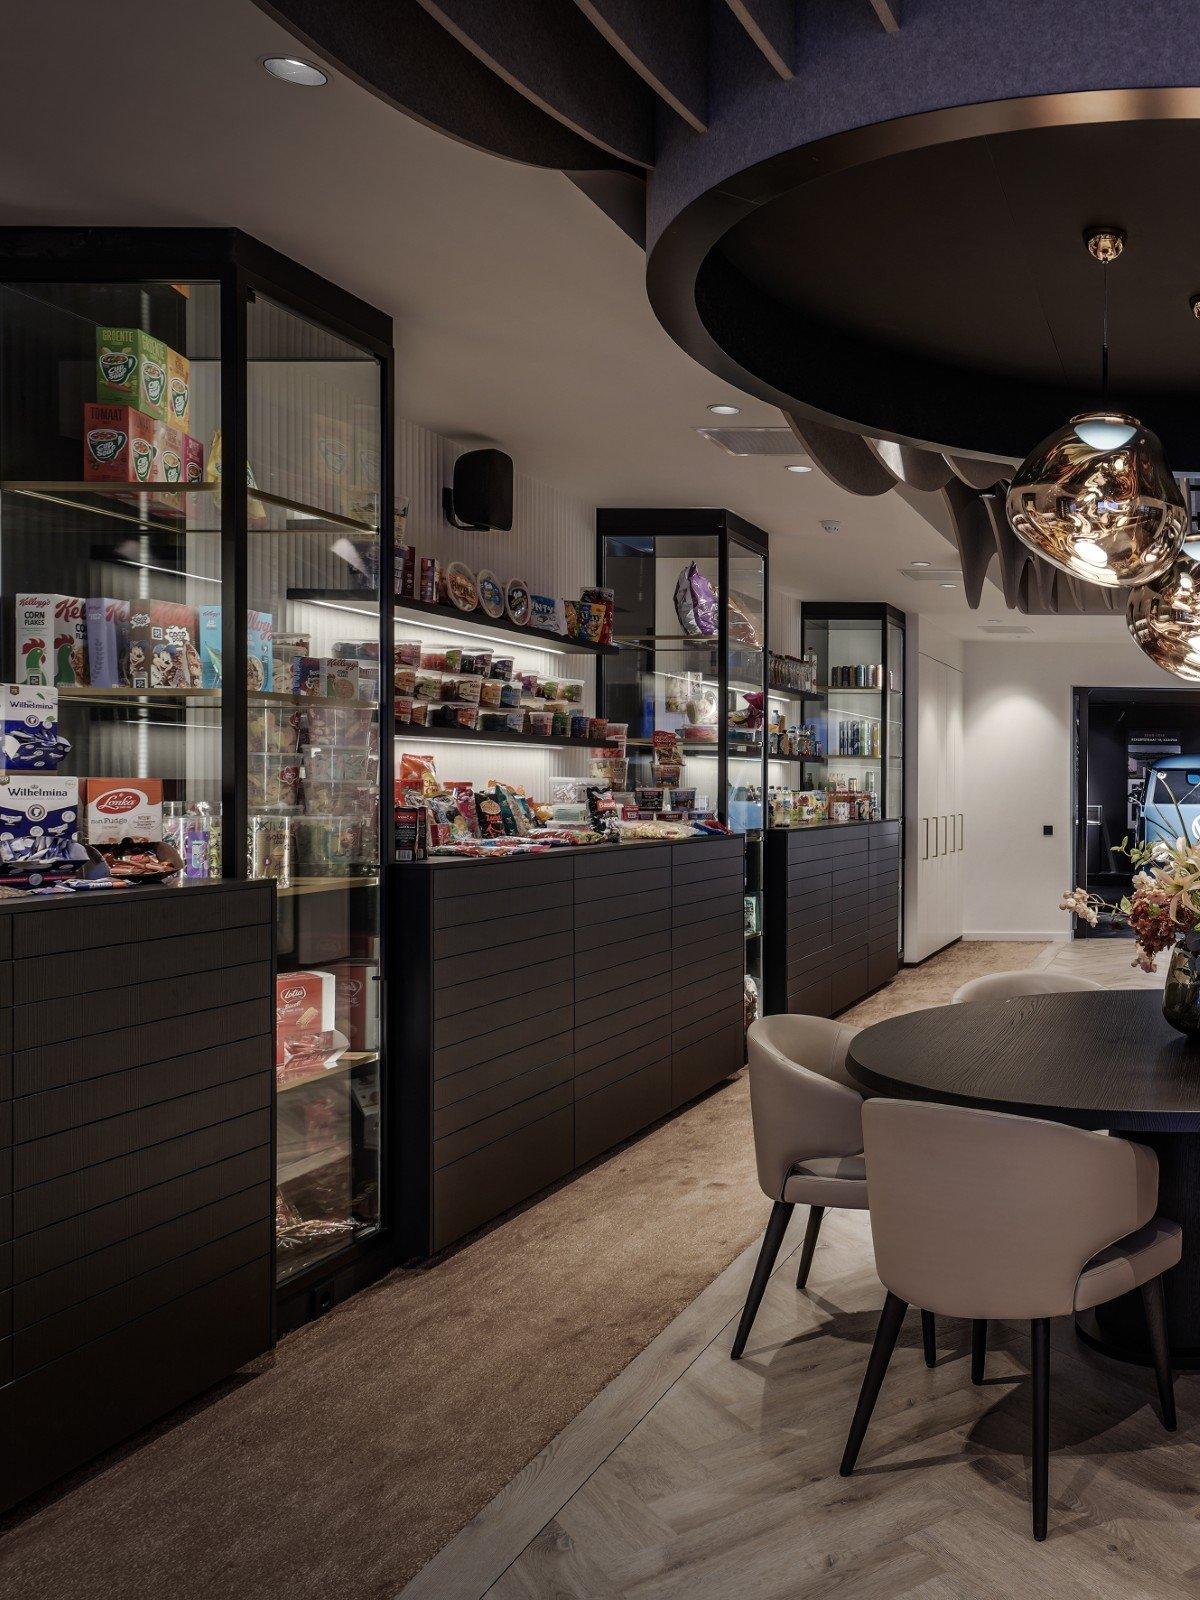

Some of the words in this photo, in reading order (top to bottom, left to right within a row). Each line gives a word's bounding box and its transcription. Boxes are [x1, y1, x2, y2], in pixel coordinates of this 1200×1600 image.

[102, 329, 134, 342] GROENTE
[91, 406, 123, 420] TOMAAT
[19, 597, 51, 608] Kellogg's
[24, 611, 45, 619] CORN
[10, 700, 54, 710] Wilhelmina
[8, 787, 68, 797] Wilhelmina
[98, 794, 136, 810] Lonka
